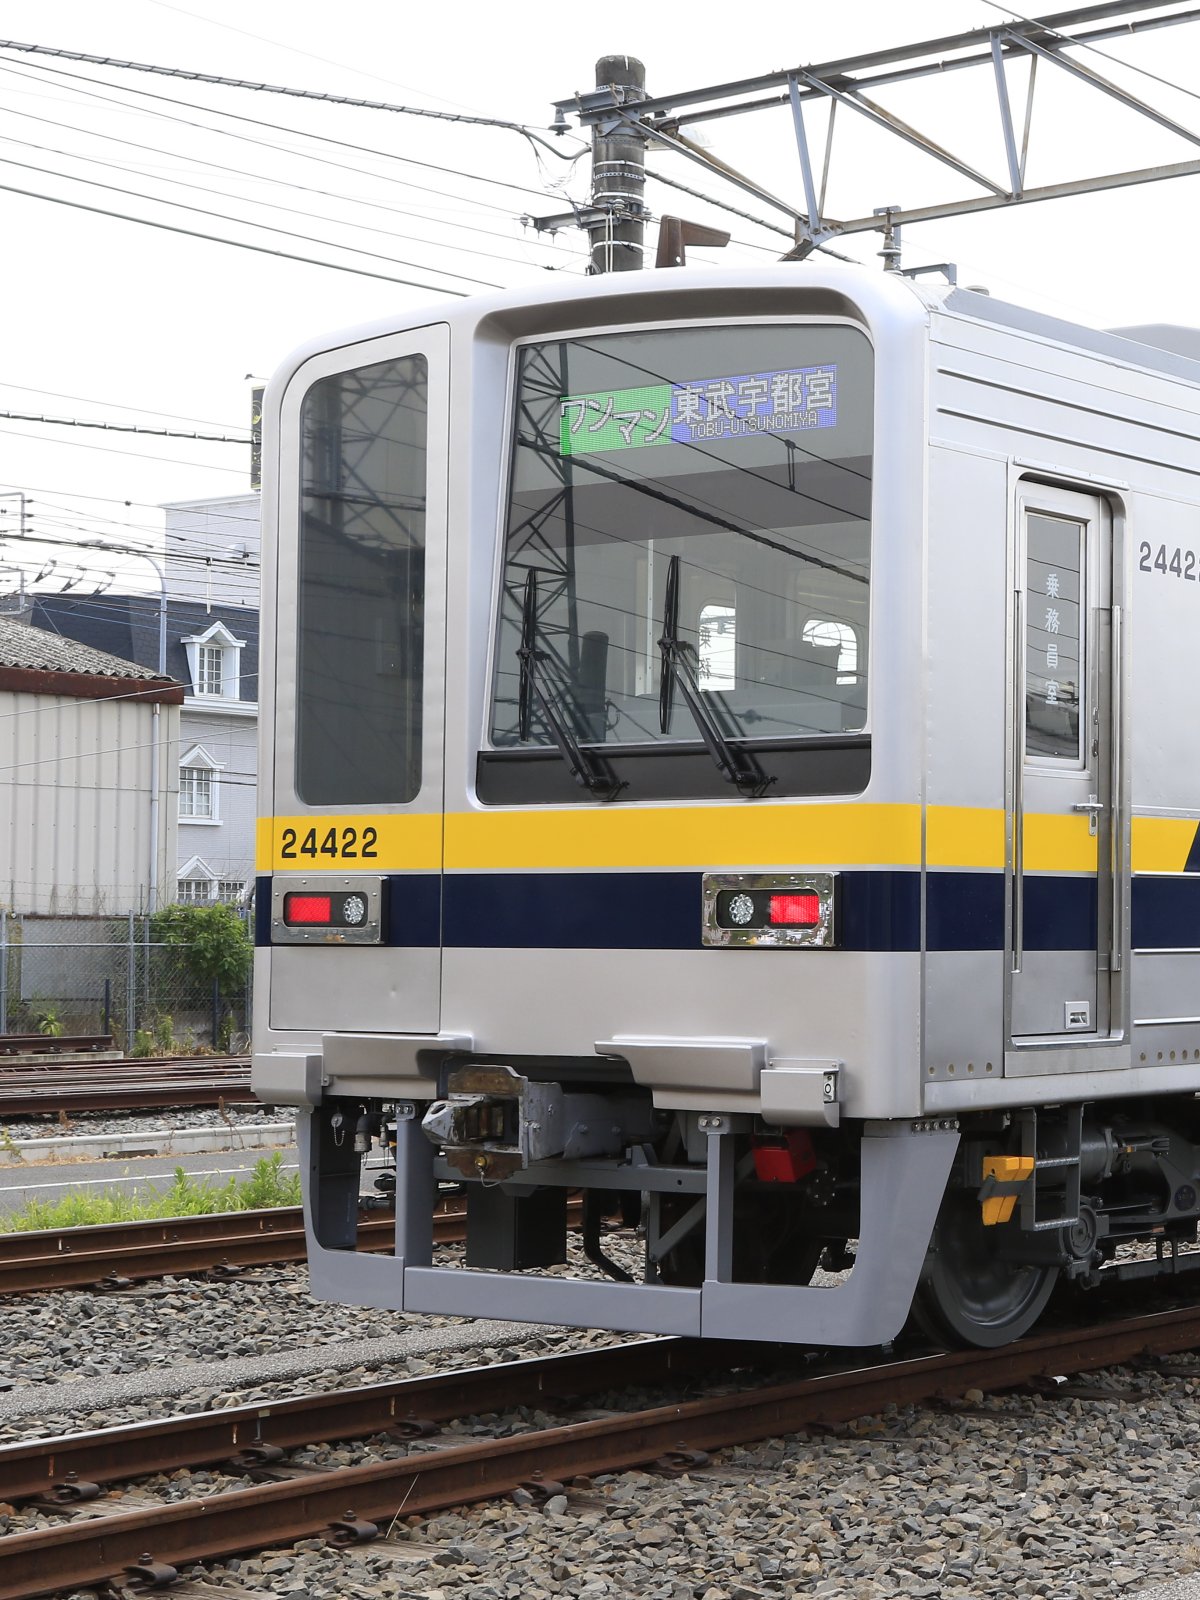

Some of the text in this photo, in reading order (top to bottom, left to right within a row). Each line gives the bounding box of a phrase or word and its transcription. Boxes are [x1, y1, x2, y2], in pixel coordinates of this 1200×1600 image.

[673, 369, 835, 424] 東武宇都宮
[689, 410, 818, 439] TOBU-UTSUNOMIYA
[1044, 573, 1061, 705] 乗務員室
[281, 827, 378, 859] 24422
